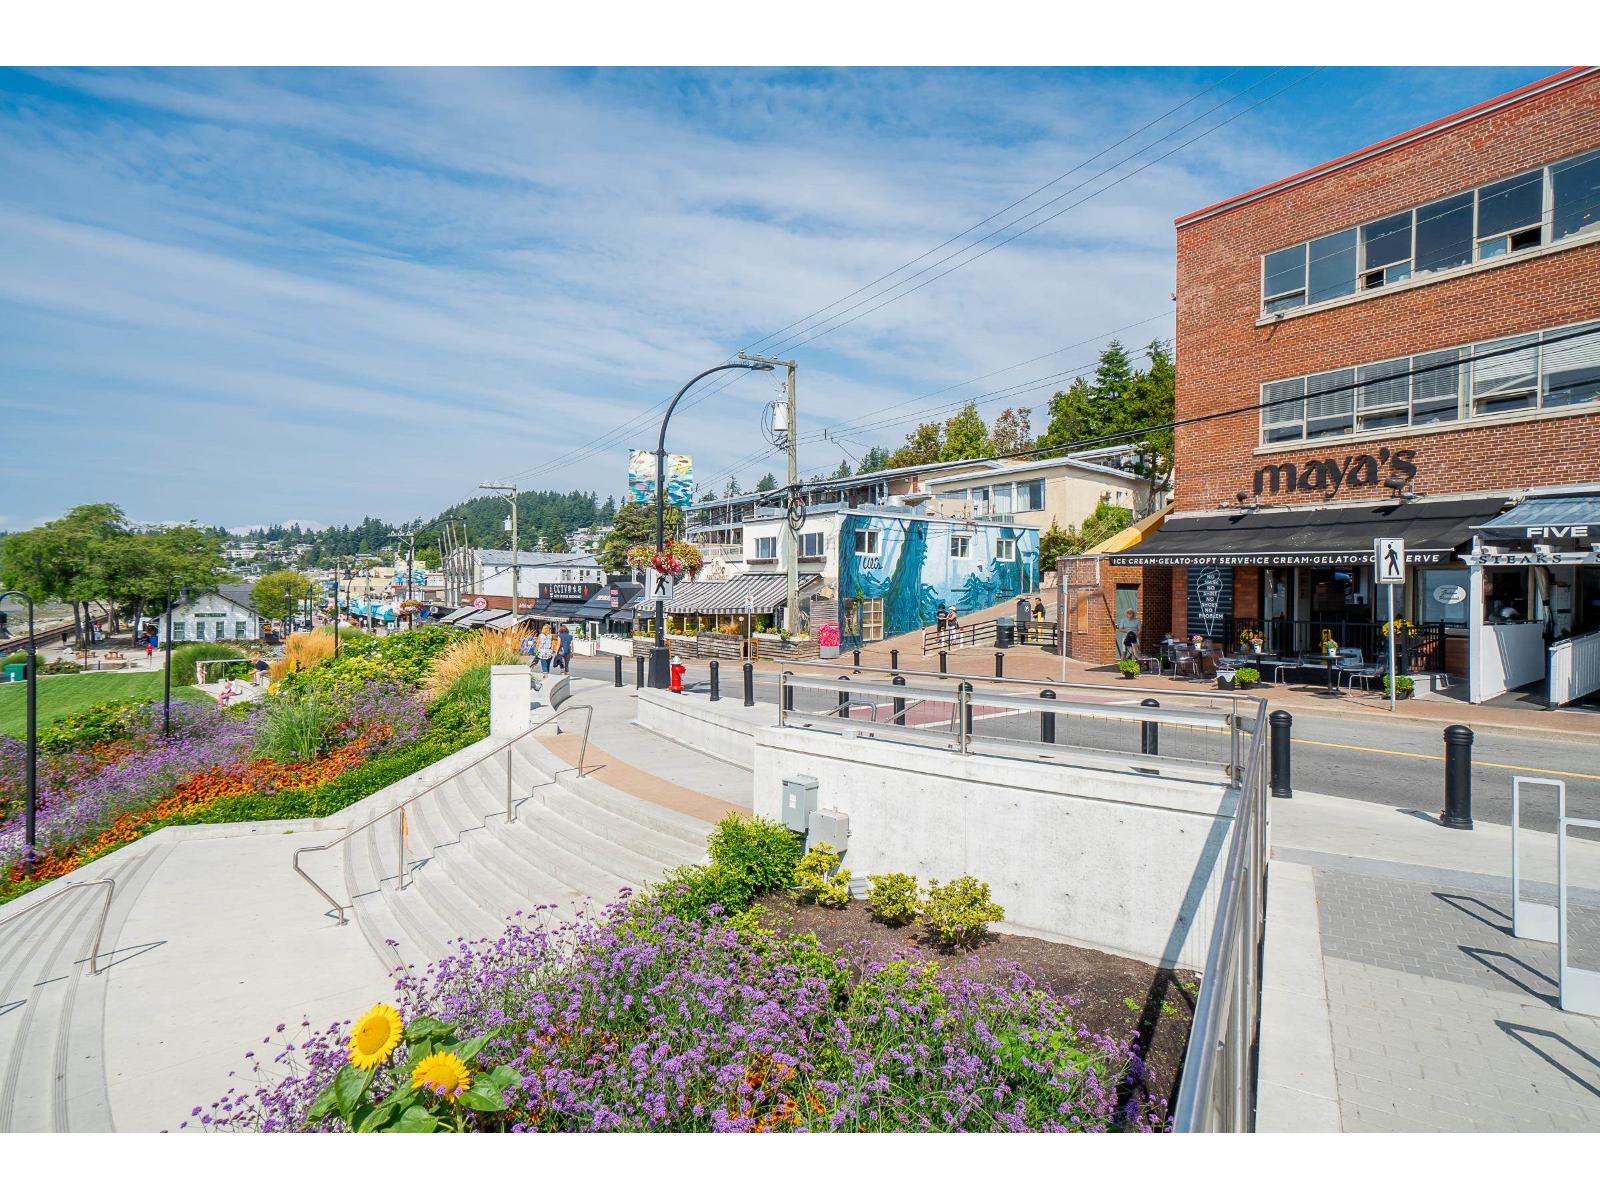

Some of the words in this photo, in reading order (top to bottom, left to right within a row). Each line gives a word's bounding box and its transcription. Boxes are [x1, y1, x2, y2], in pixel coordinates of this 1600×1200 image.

[1254, 447, 1417, 498] maya's
[1526, 526, 1588, 538] FIVE
[1406, 554, 1440, 563] ERVE
[1478, 554, 1562, 564] STEAKS
